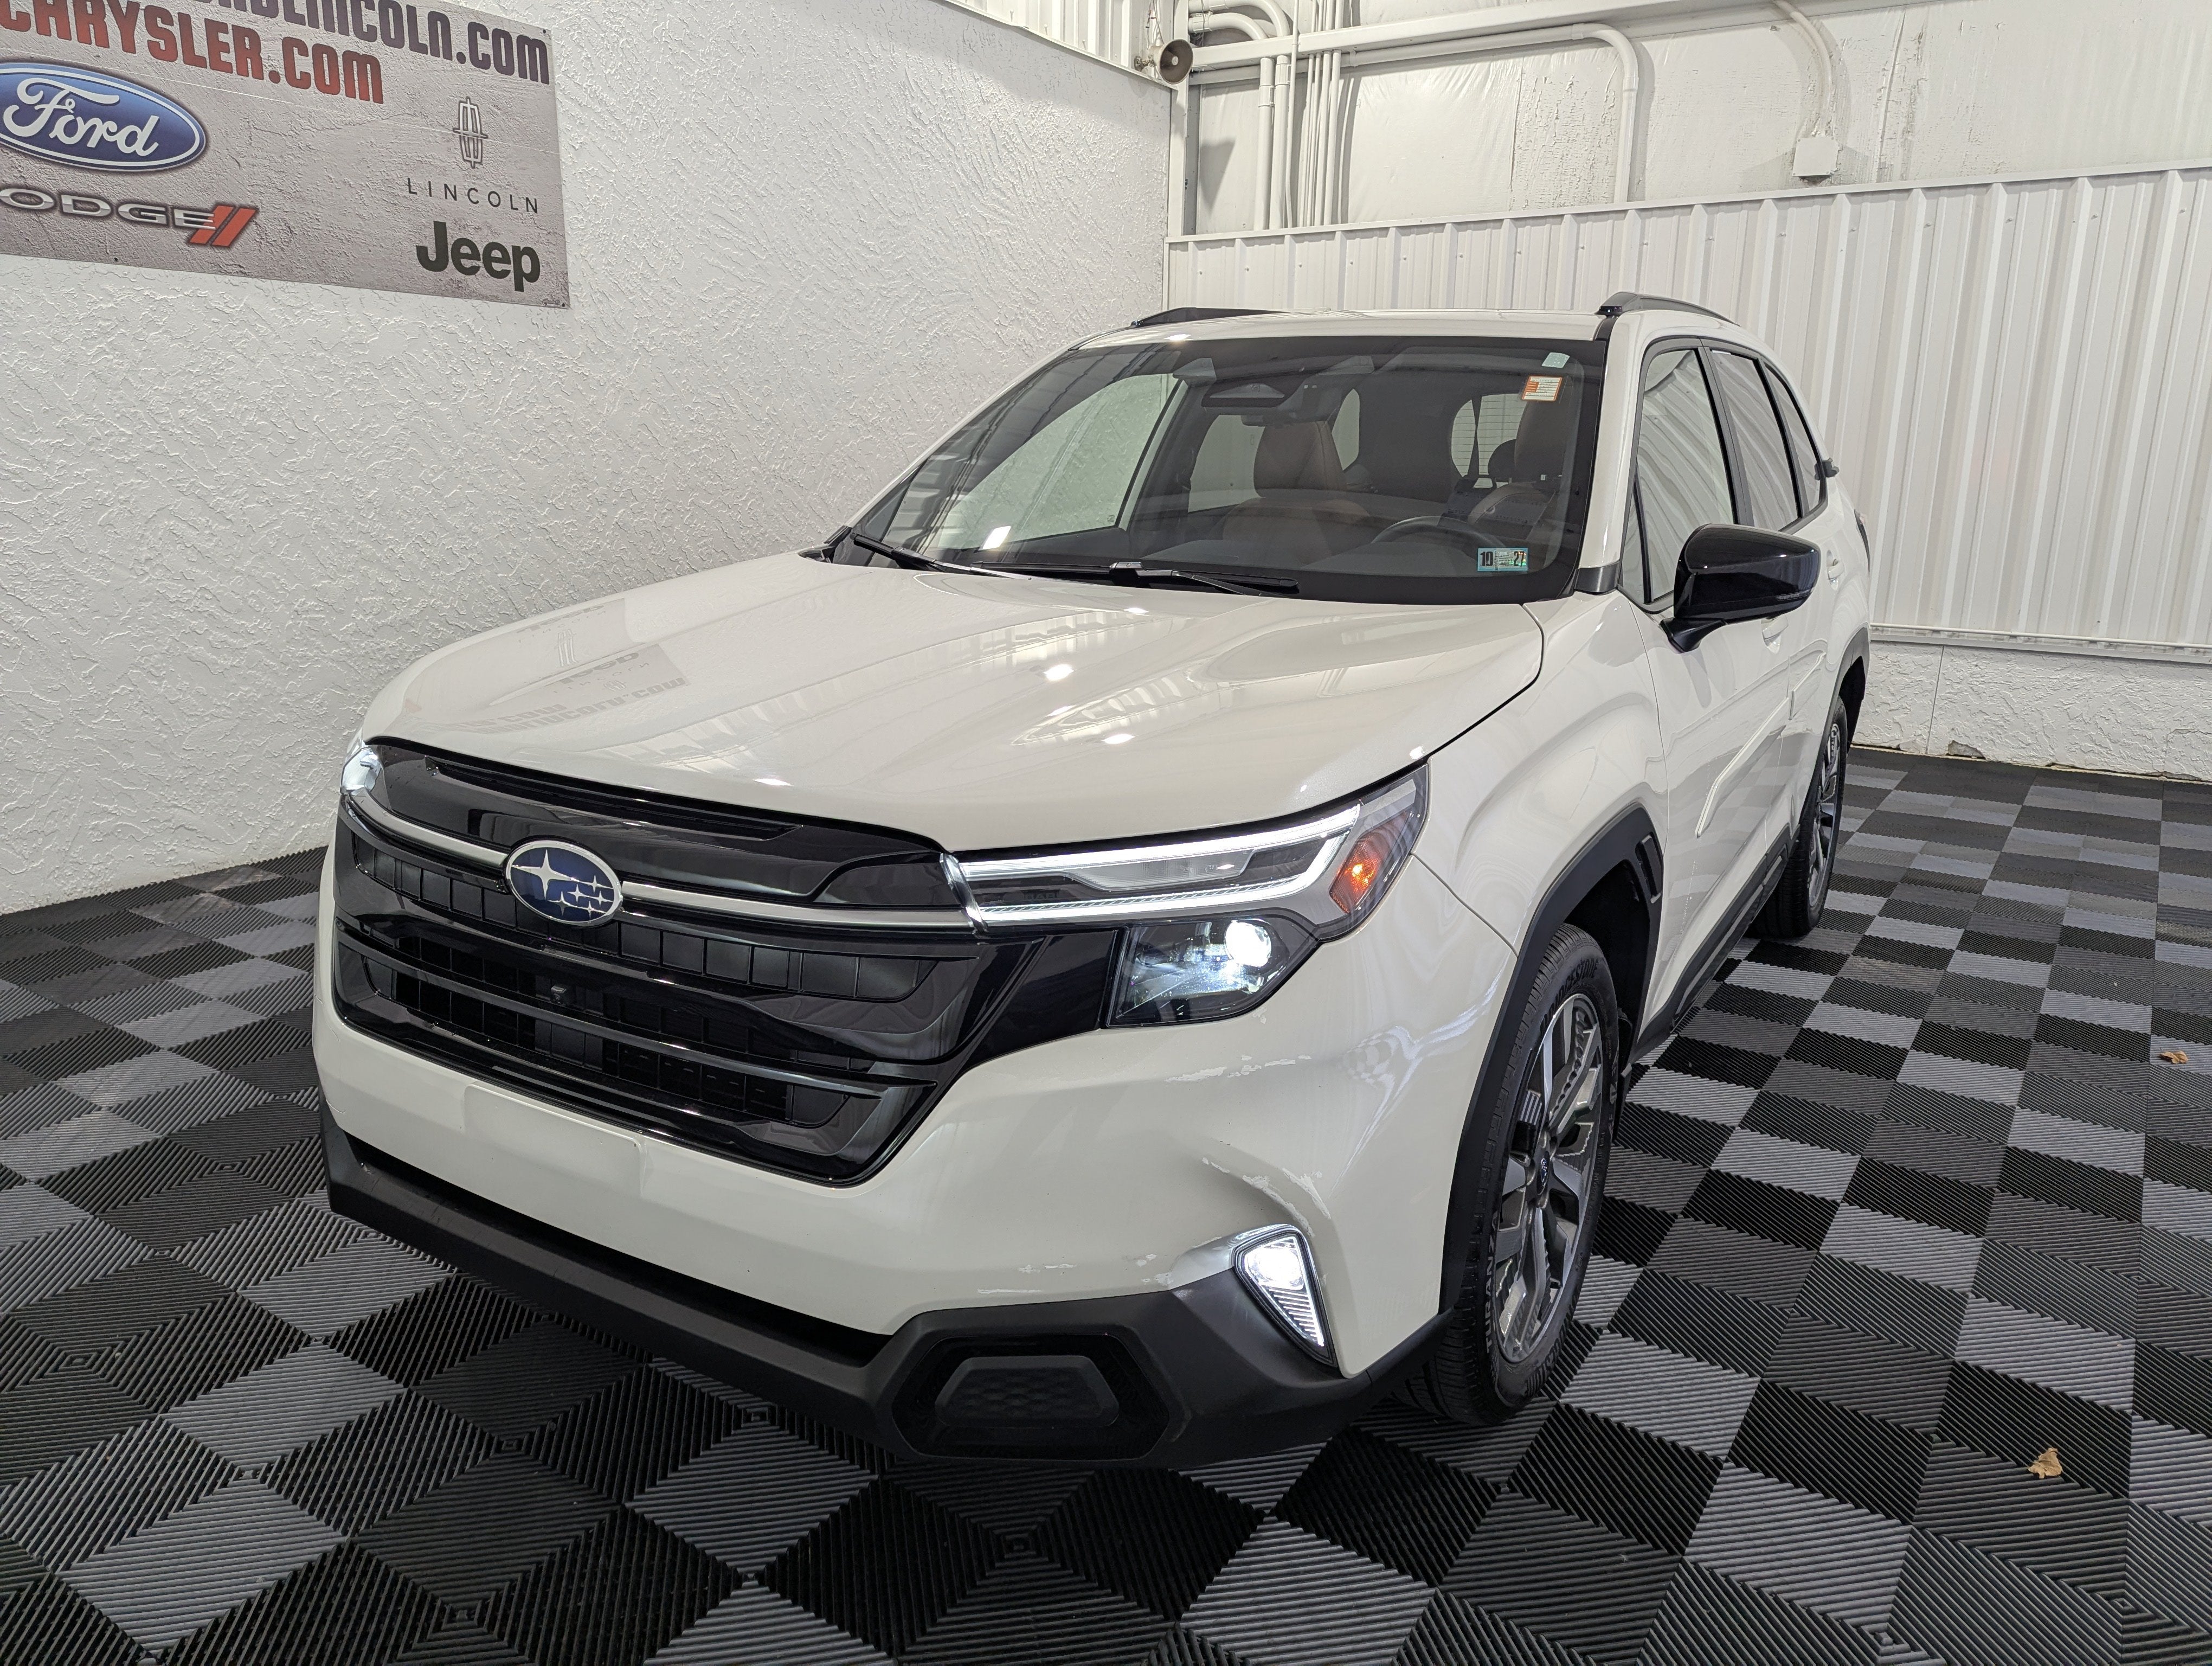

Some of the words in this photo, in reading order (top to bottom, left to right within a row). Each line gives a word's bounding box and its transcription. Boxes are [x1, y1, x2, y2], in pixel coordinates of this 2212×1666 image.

[193, 0, 549, 85] INCOLN.COM
[3, 77, 160, 156] Ford
[407, 177, 538, 214] LINCOLN
[416, 220, 541, 292] Jeep
[1480, 551, 1494, 567] 10
[1484, 1210, 1498, 1354] TURANZA
